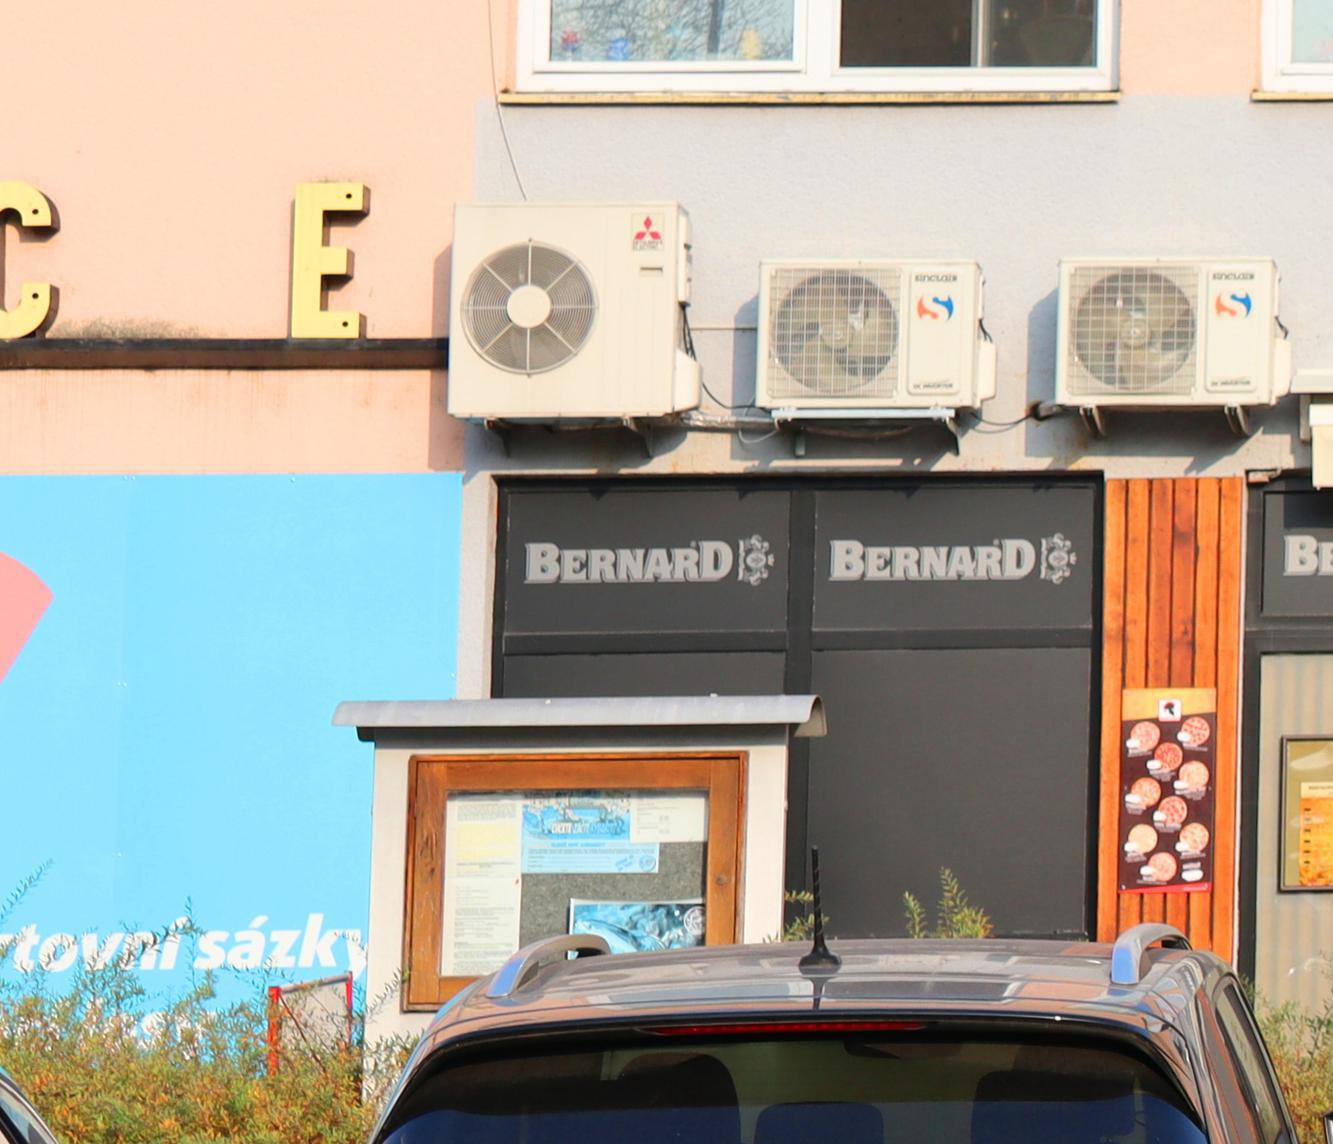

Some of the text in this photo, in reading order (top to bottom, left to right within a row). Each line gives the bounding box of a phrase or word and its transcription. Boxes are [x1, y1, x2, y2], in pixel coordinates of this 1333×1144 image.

[523, 540, 734, 585] BERNARD
[828, 538, 1036, 582] BERNARD
[192, 913, 368, 982] sázky
